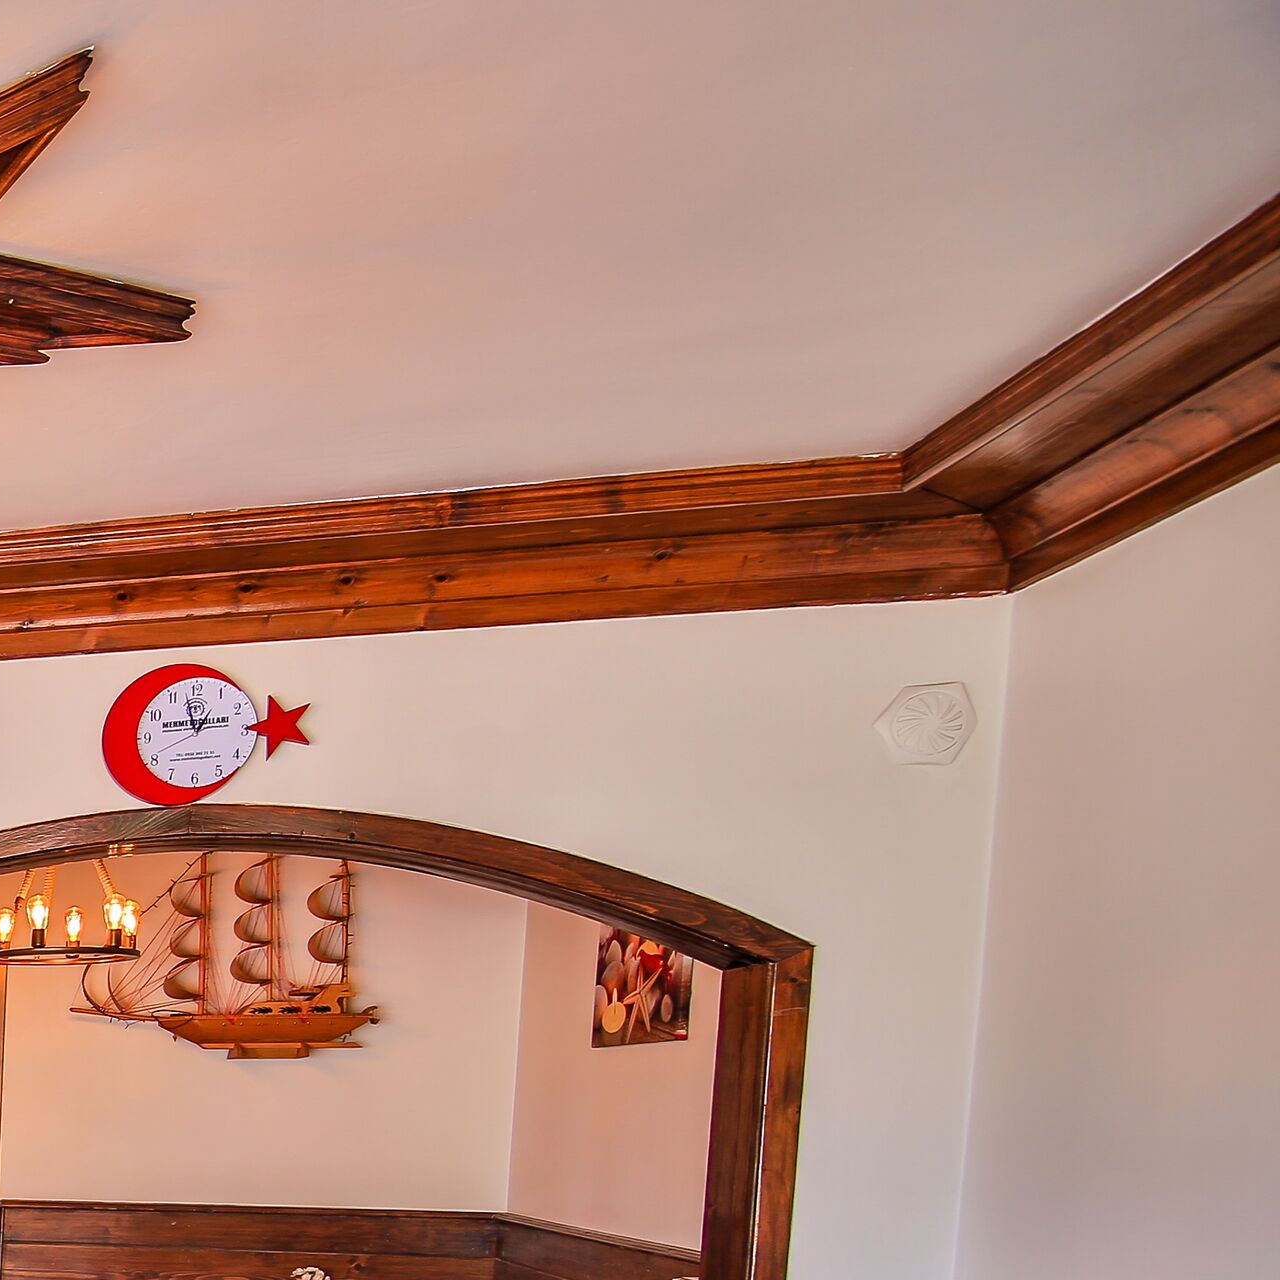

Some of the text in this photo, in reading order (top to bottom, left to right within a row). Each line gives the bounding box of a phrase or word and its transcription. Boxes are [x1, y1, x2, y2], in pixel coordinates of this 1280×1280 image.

[191, 684, 203, 697] 12
[169, 691, 177, 704] 11
[150, 709, 162, 722] 10
[233, 703, 242, 715] 2
[240, 724, 249, 736] 3
[143, 732, 152, 744] 9
[150, 753, 159, 766] 8
[232, 748, 240, 760] 4
[168, 768, 175, 781] 7
[214, 765, 223, 777] 5
[191, 772, 199, 785] 6
